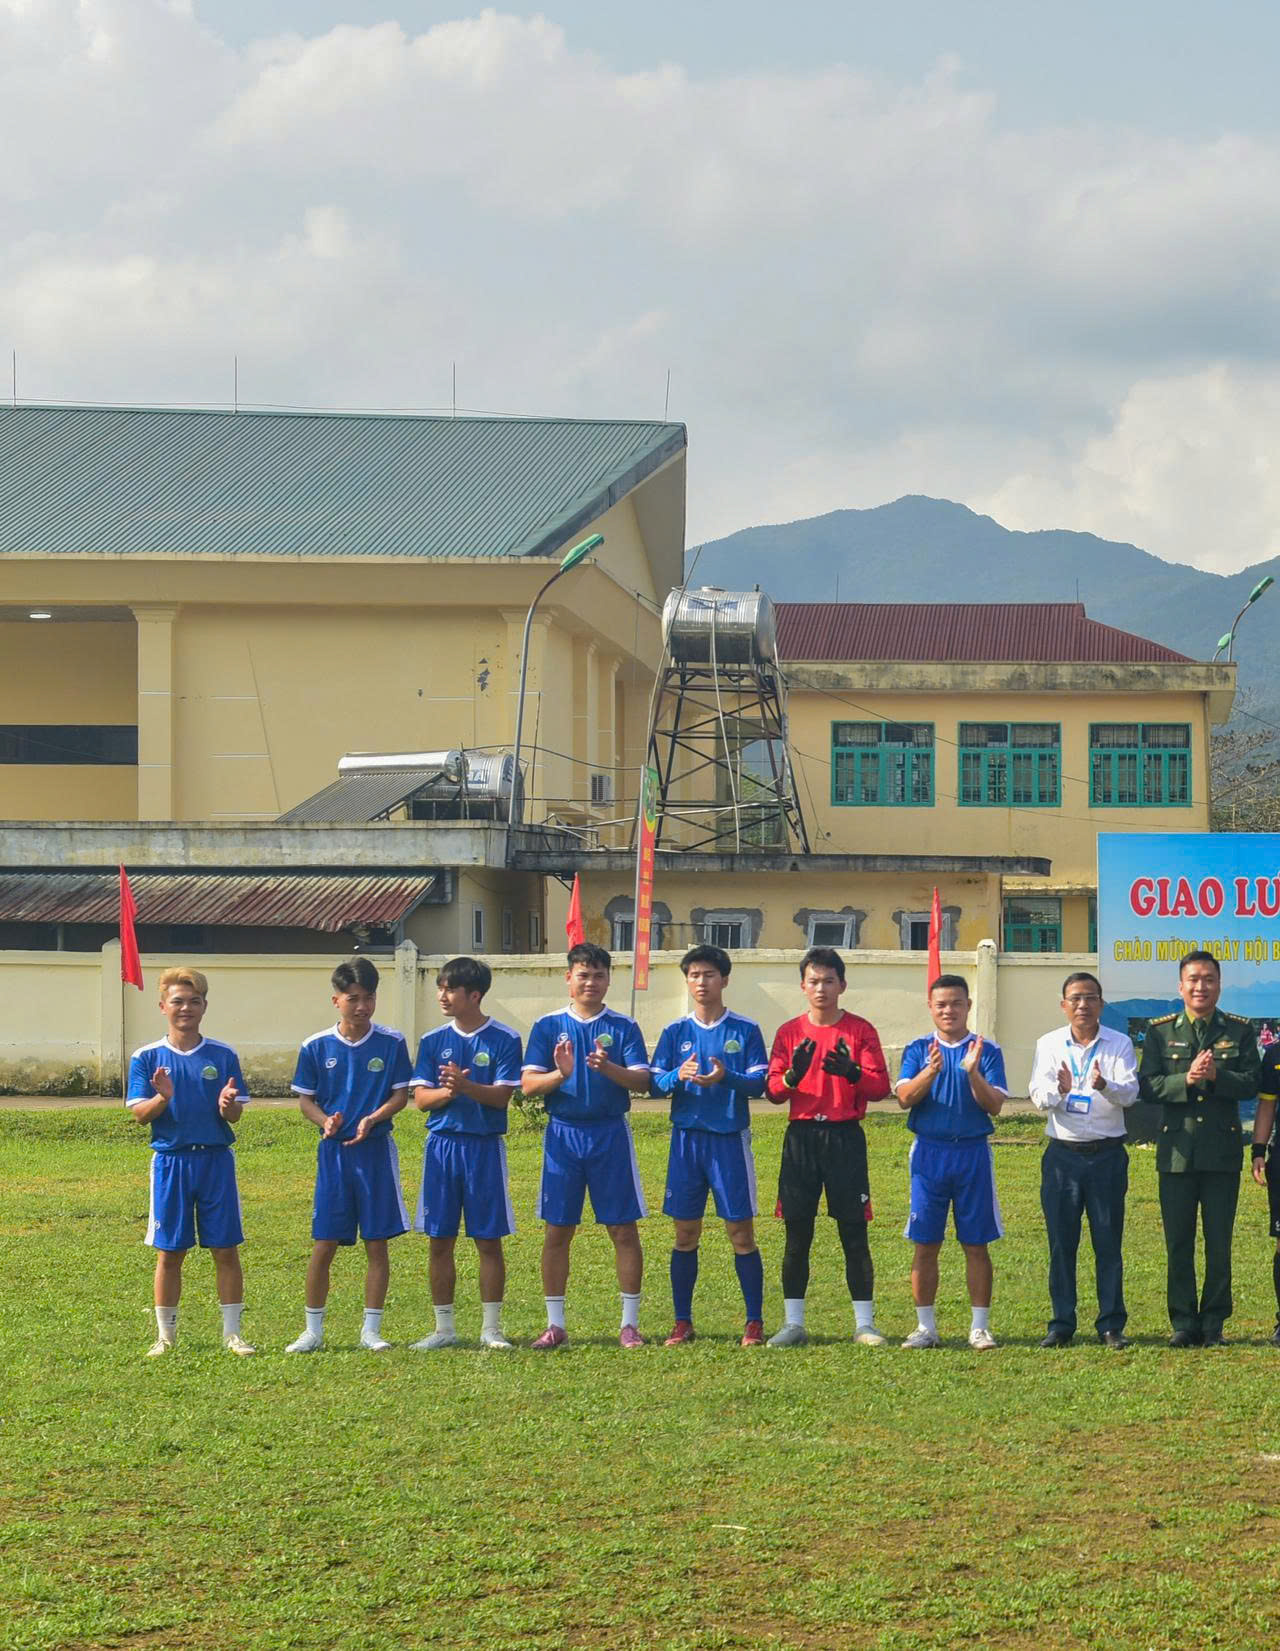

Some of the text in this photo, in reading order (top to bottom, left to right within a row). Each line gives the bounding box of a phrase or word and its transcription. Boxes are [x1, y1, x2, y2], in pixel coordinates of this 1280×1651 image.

[1129, 877, 1224, 917] GIAO
[1114, 936, 1152, 961] CHÀO
[1244, 936, 1268, 966] HỘI
